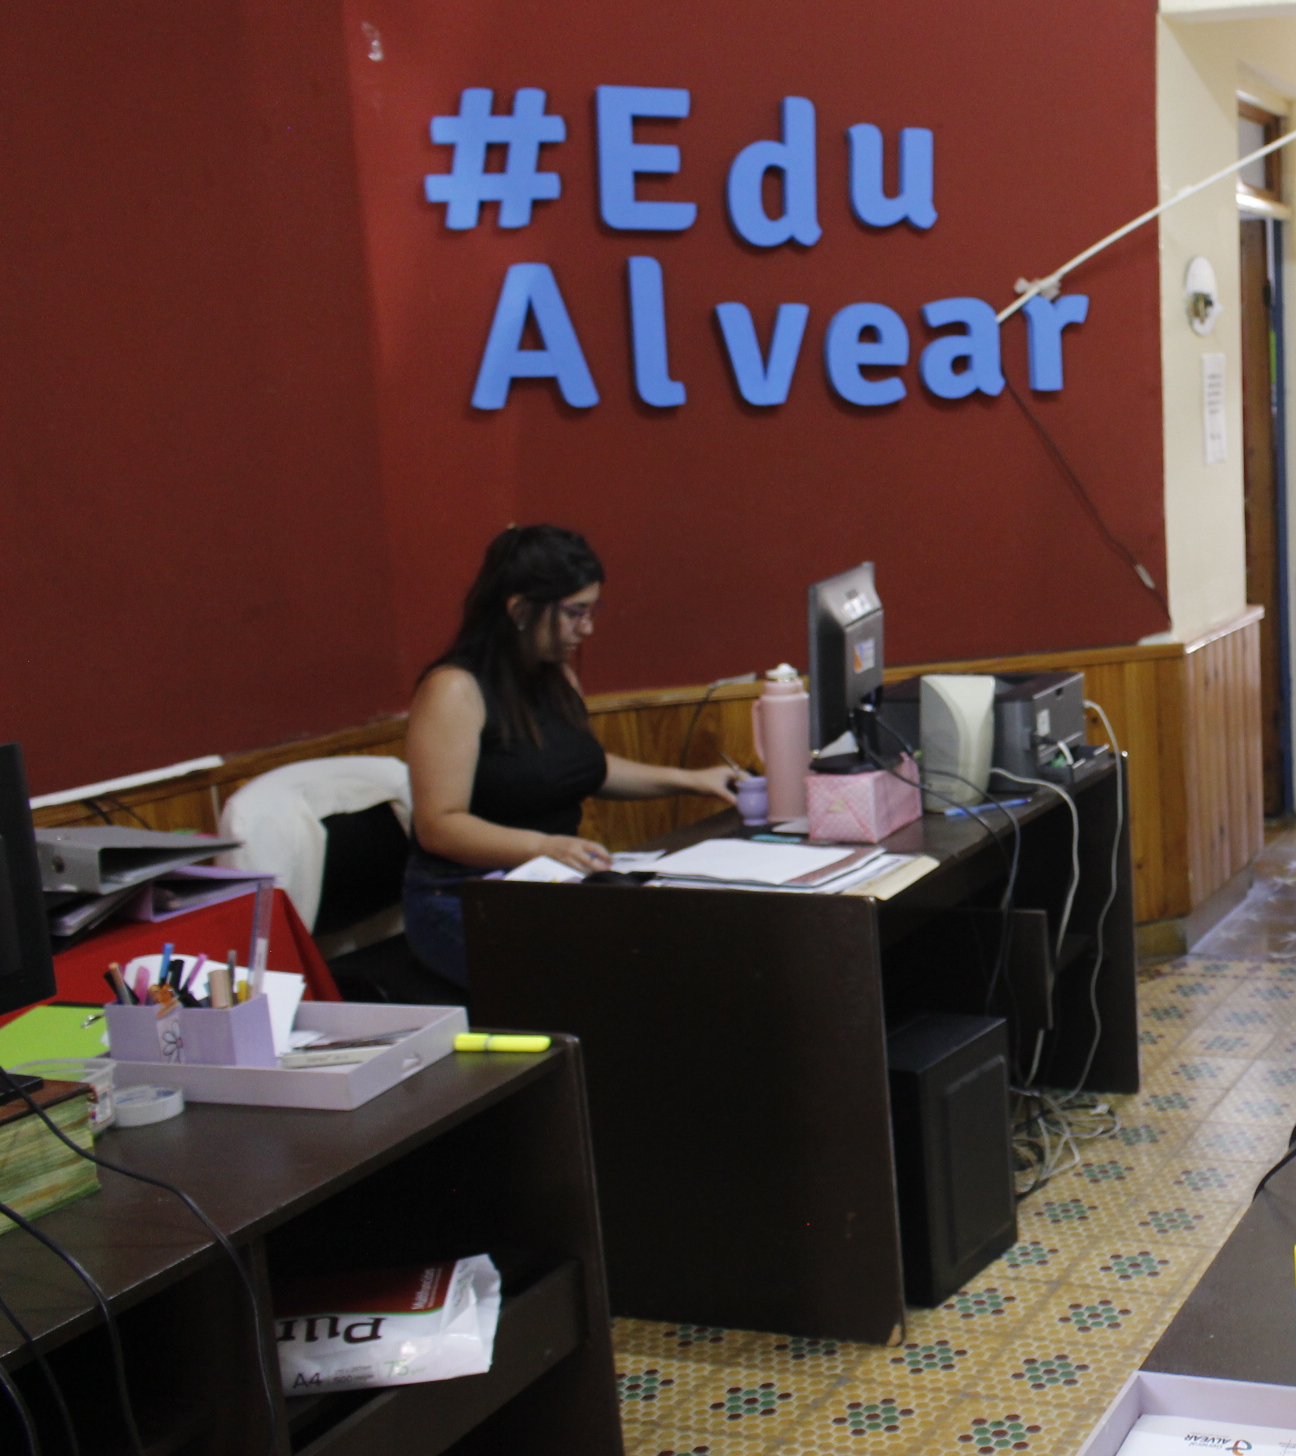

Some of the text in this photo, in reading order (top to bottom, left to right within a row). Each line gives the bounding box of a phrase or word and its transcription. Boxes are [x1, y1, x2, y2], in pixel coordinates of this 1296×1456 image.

[424, 84, 939, 247] #Edu
[470, 255, 1090, 410] Alvear
[292, 1371, 323, 1390] A4
[1184, 1434, 1231, 1446] ALVEAR
